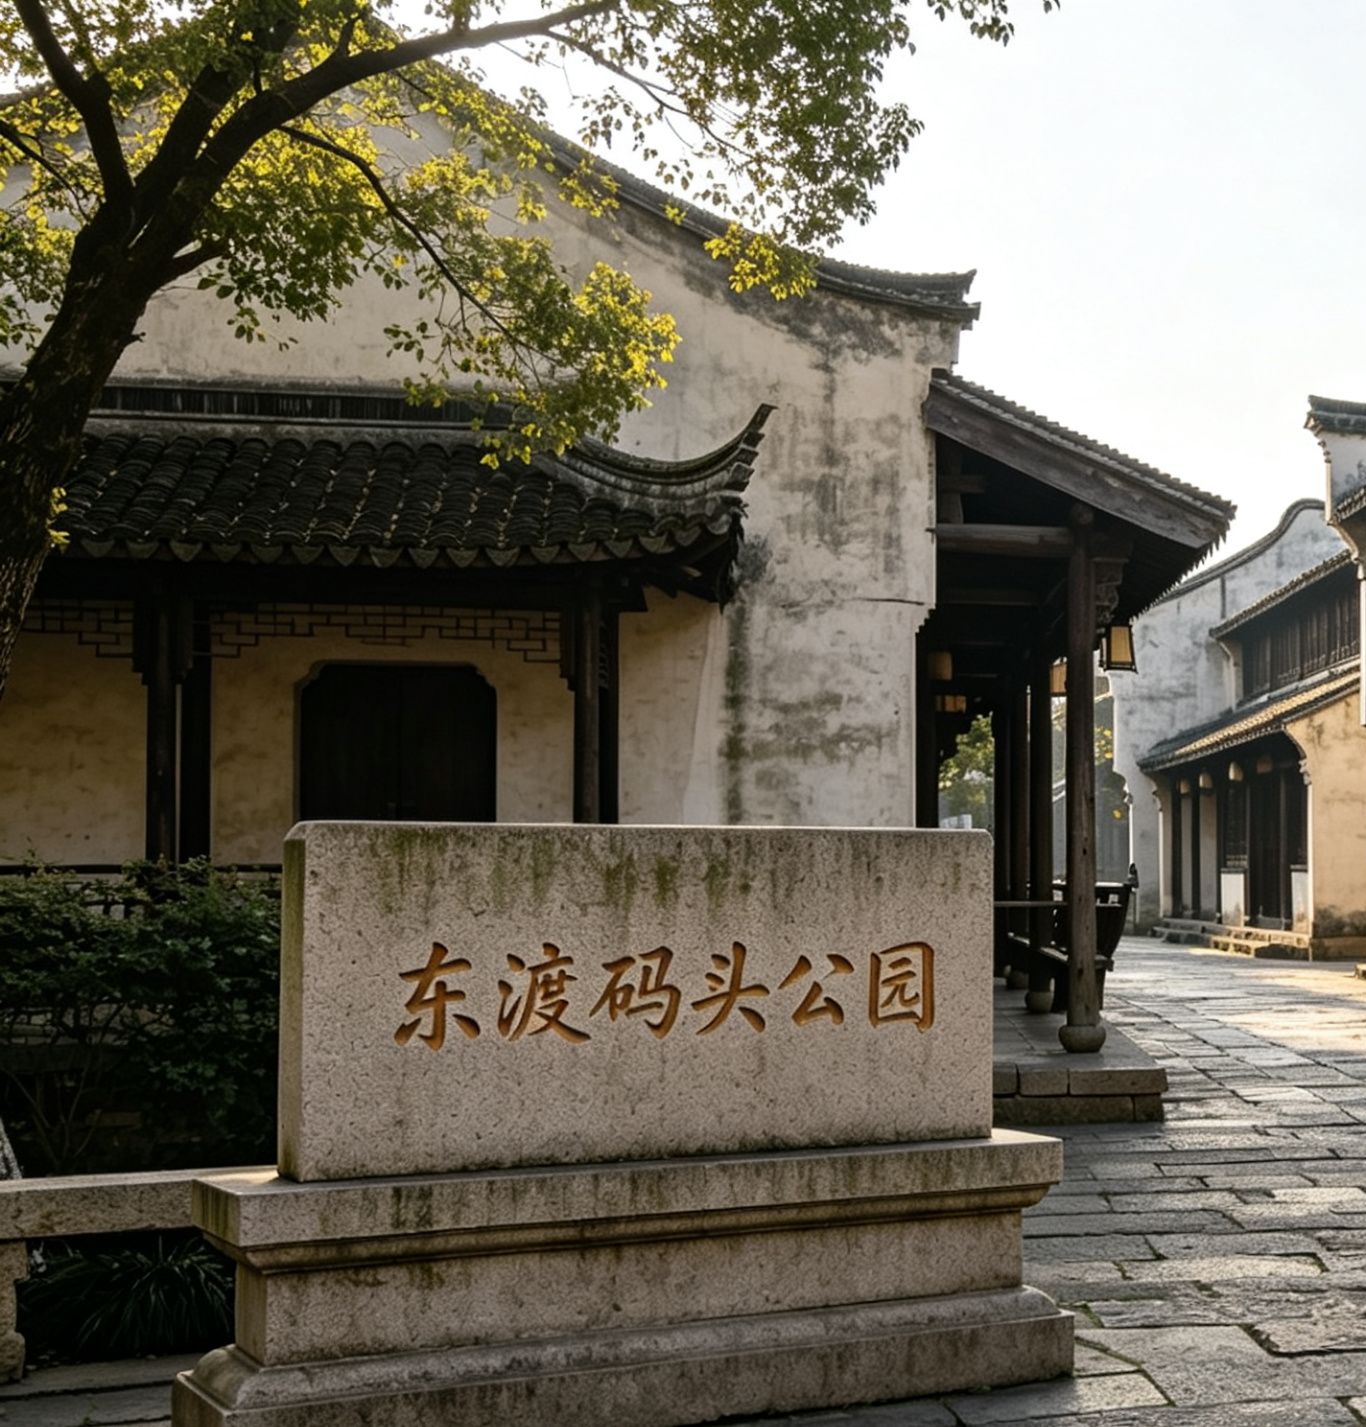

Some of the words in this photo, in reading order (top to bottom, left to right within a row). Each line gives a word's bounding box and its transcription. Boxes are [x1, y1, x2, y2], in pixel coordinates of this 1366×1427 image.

[394, 941, 936, 1049] 东渡码头公园
